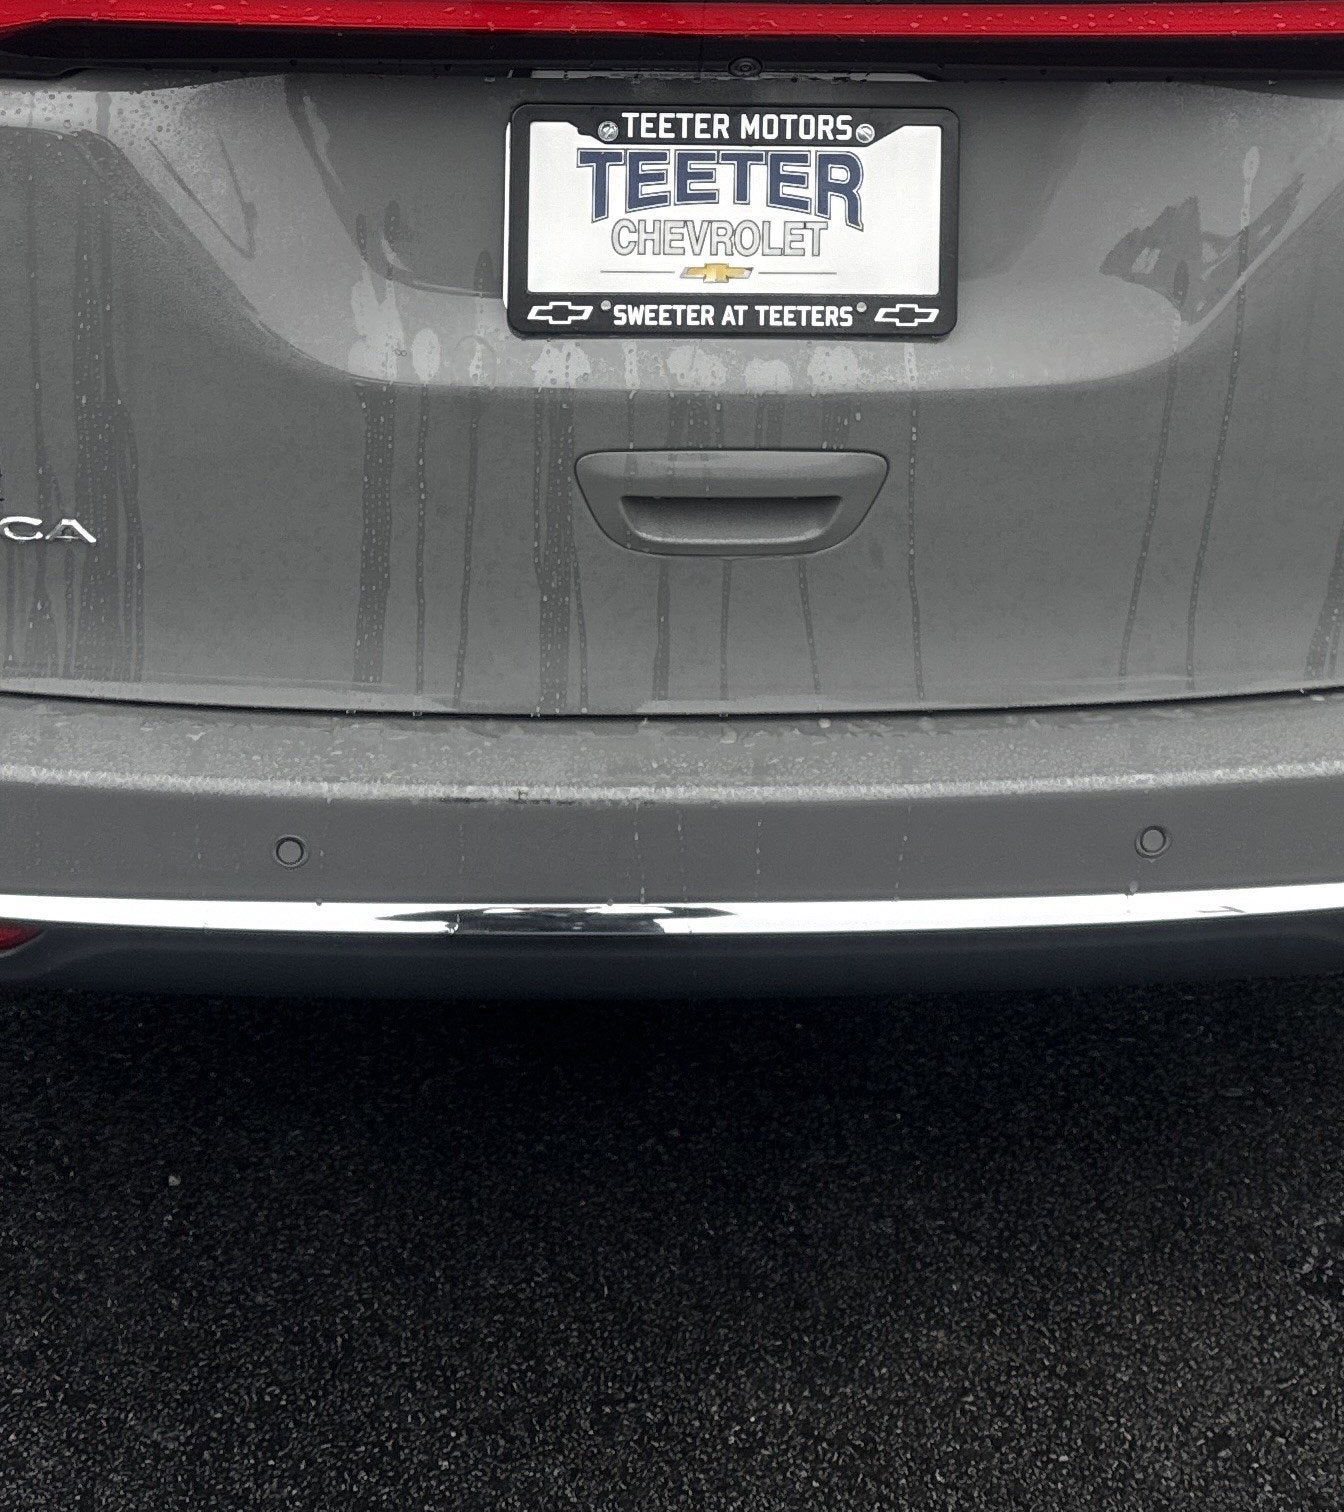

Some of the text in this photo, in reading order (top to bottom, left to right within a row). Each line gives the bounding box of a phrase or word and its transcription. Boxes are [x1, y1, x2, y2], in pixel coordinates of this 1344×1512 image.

[622, 112, 853, 141] TEETER MOTORS
[576, 147, 864, 232] TEETER
[611, 219, 829, 257] CHEVROLET
[613, 304, 853, 327] SWEETER AT TEETERS
